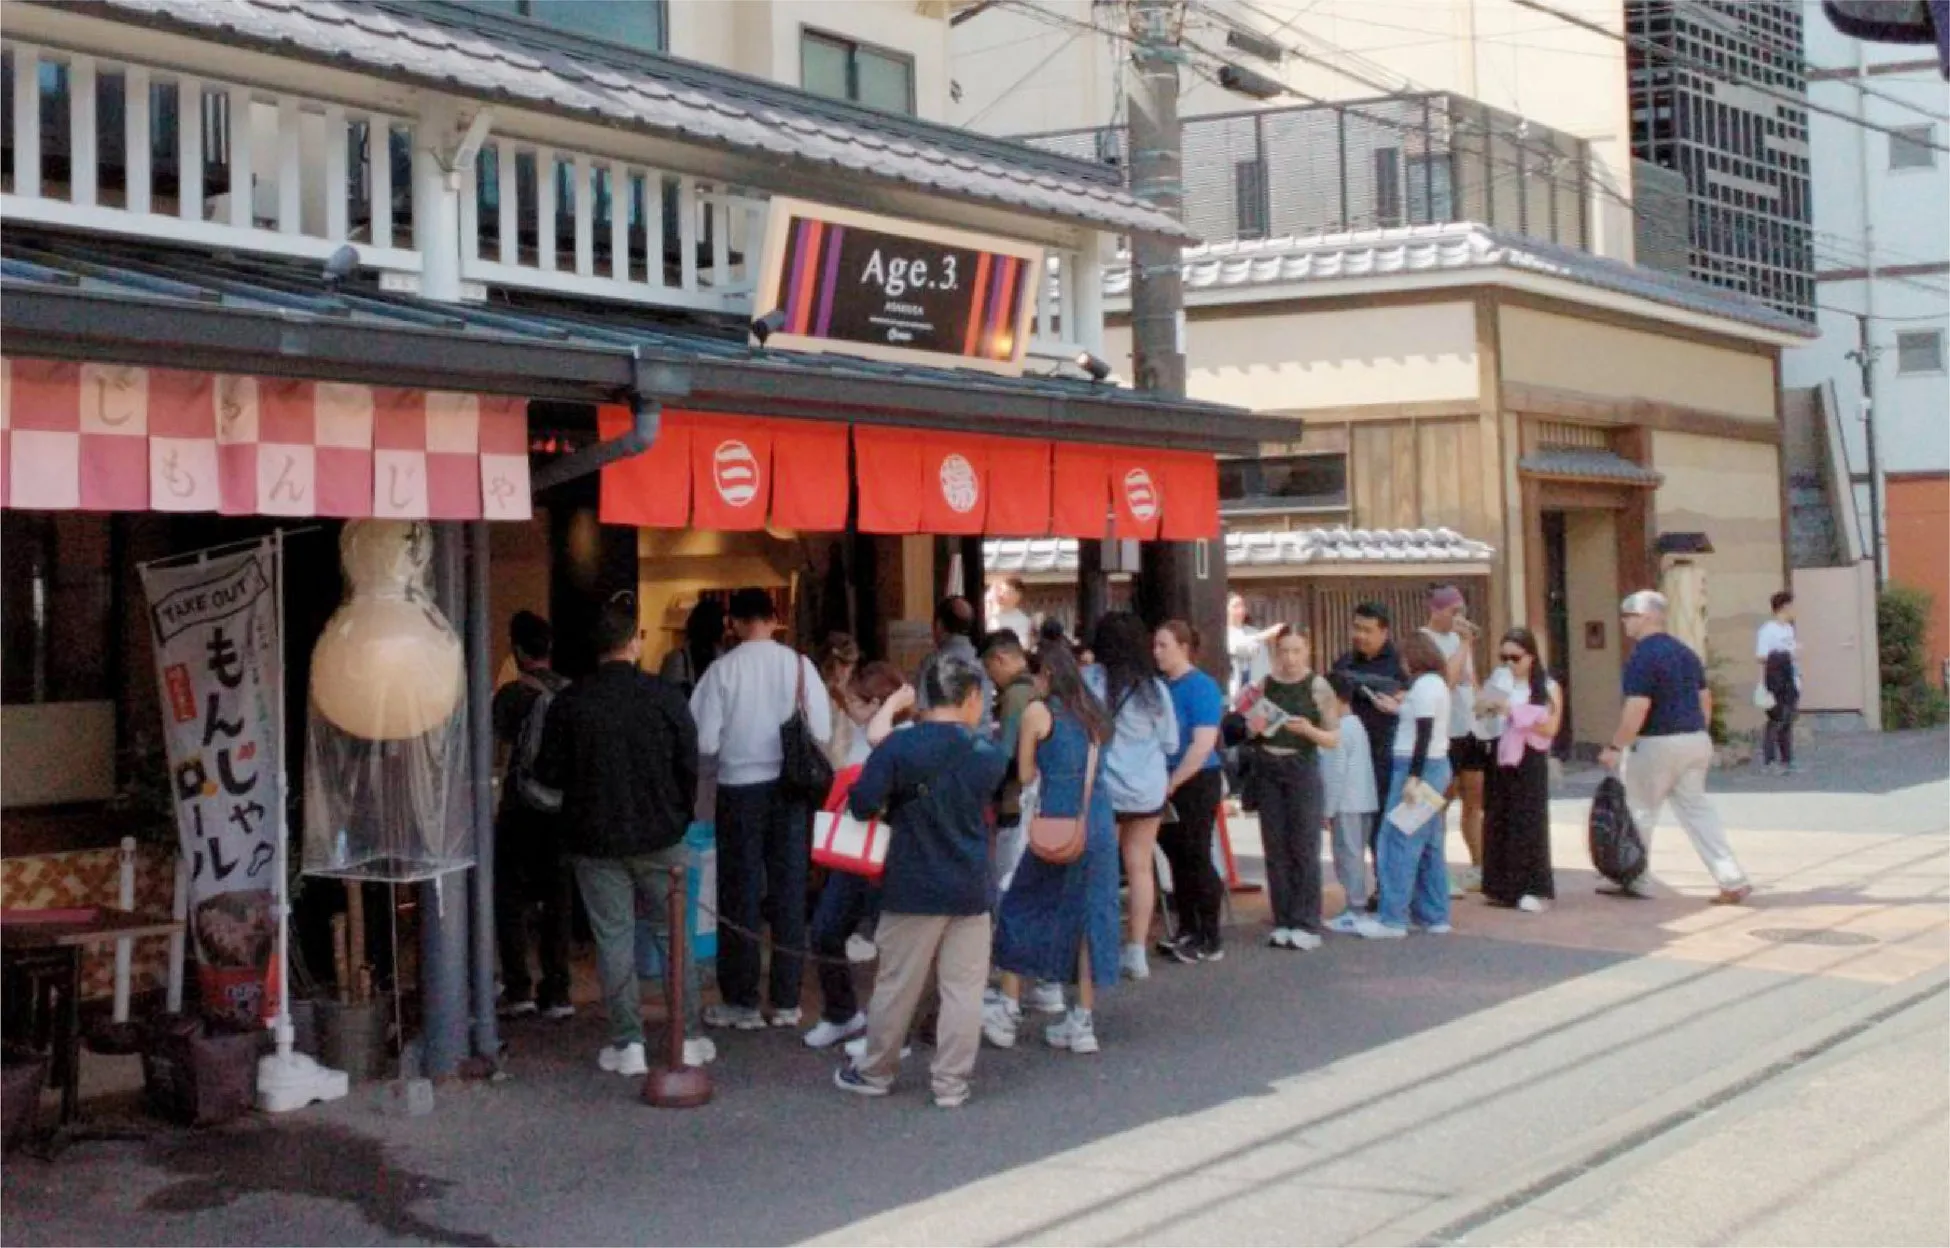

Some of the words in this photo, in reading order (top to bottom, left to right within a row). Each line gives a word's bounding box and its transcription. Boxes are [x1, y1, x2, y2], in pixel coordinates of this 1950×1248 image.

[162, 593, 207, 624] TAKE
[211, 576, 247, 609] OUT
[202, 626, 266, 834] もんじゃ
